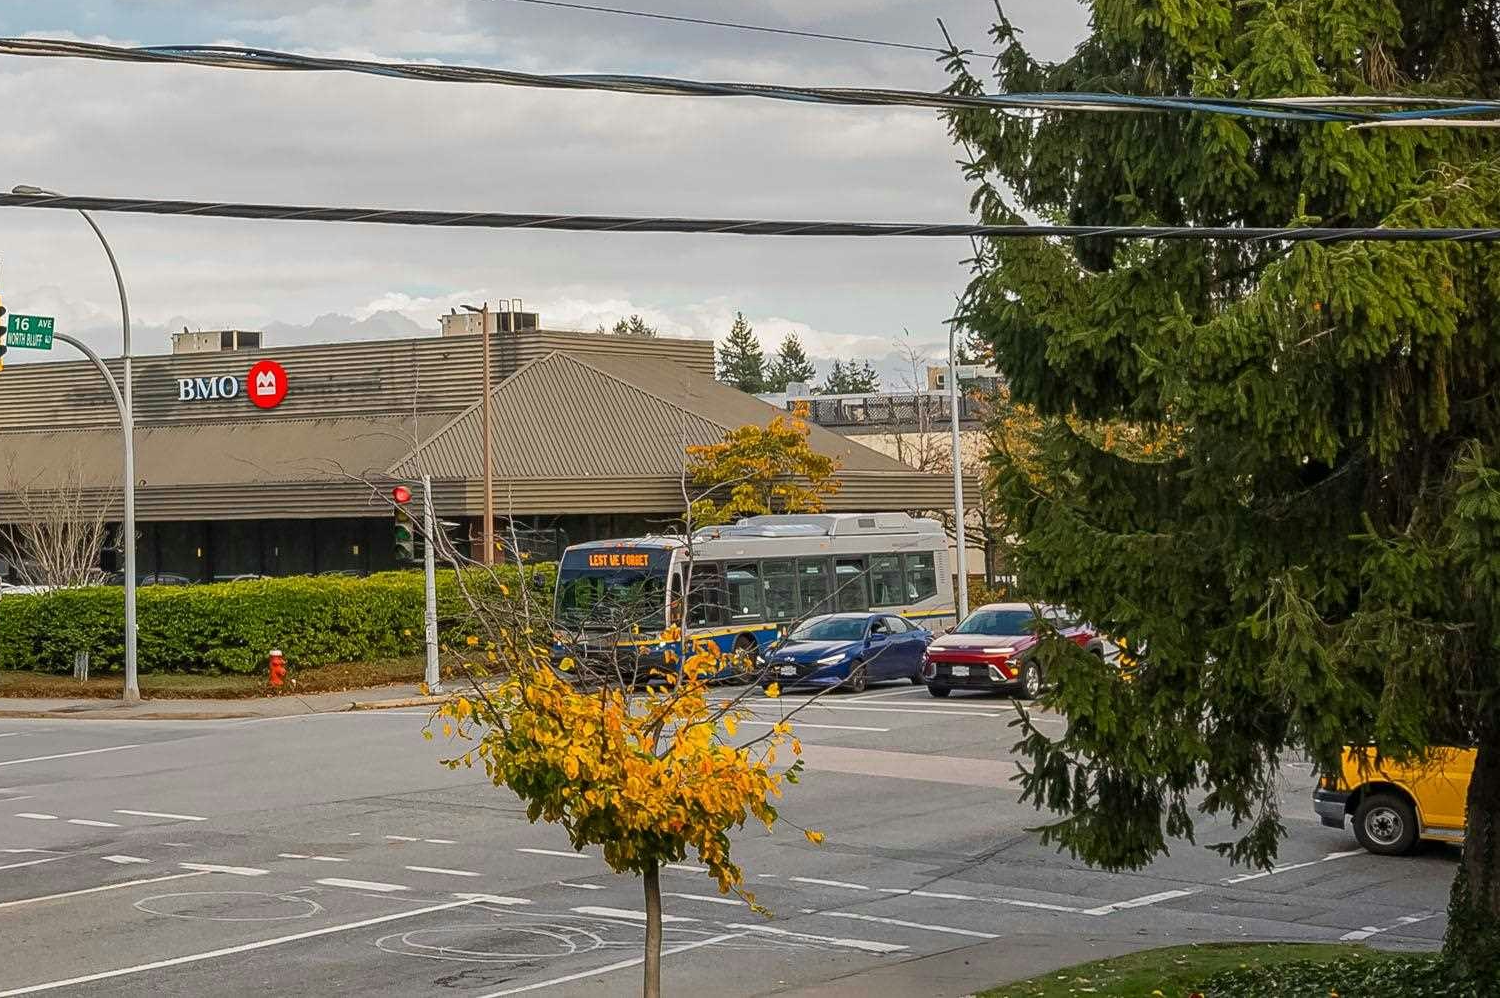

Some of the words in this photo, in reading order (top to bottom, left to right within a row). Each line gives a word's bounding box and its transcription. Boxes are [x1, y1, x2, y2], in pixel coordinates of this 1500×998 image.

[14, 317, 30, 331] 16
[37, 319, 53, 329] AVE
[7, 332, 26, 346] NORTH
[26, 333, 43, 347] BLUFF
[177, 375, 239, 401] BMO
[589, 554, 607, 566] LEST
[609, 554, 620, 566] WE
[621, 554, 649, 566] FORGET
